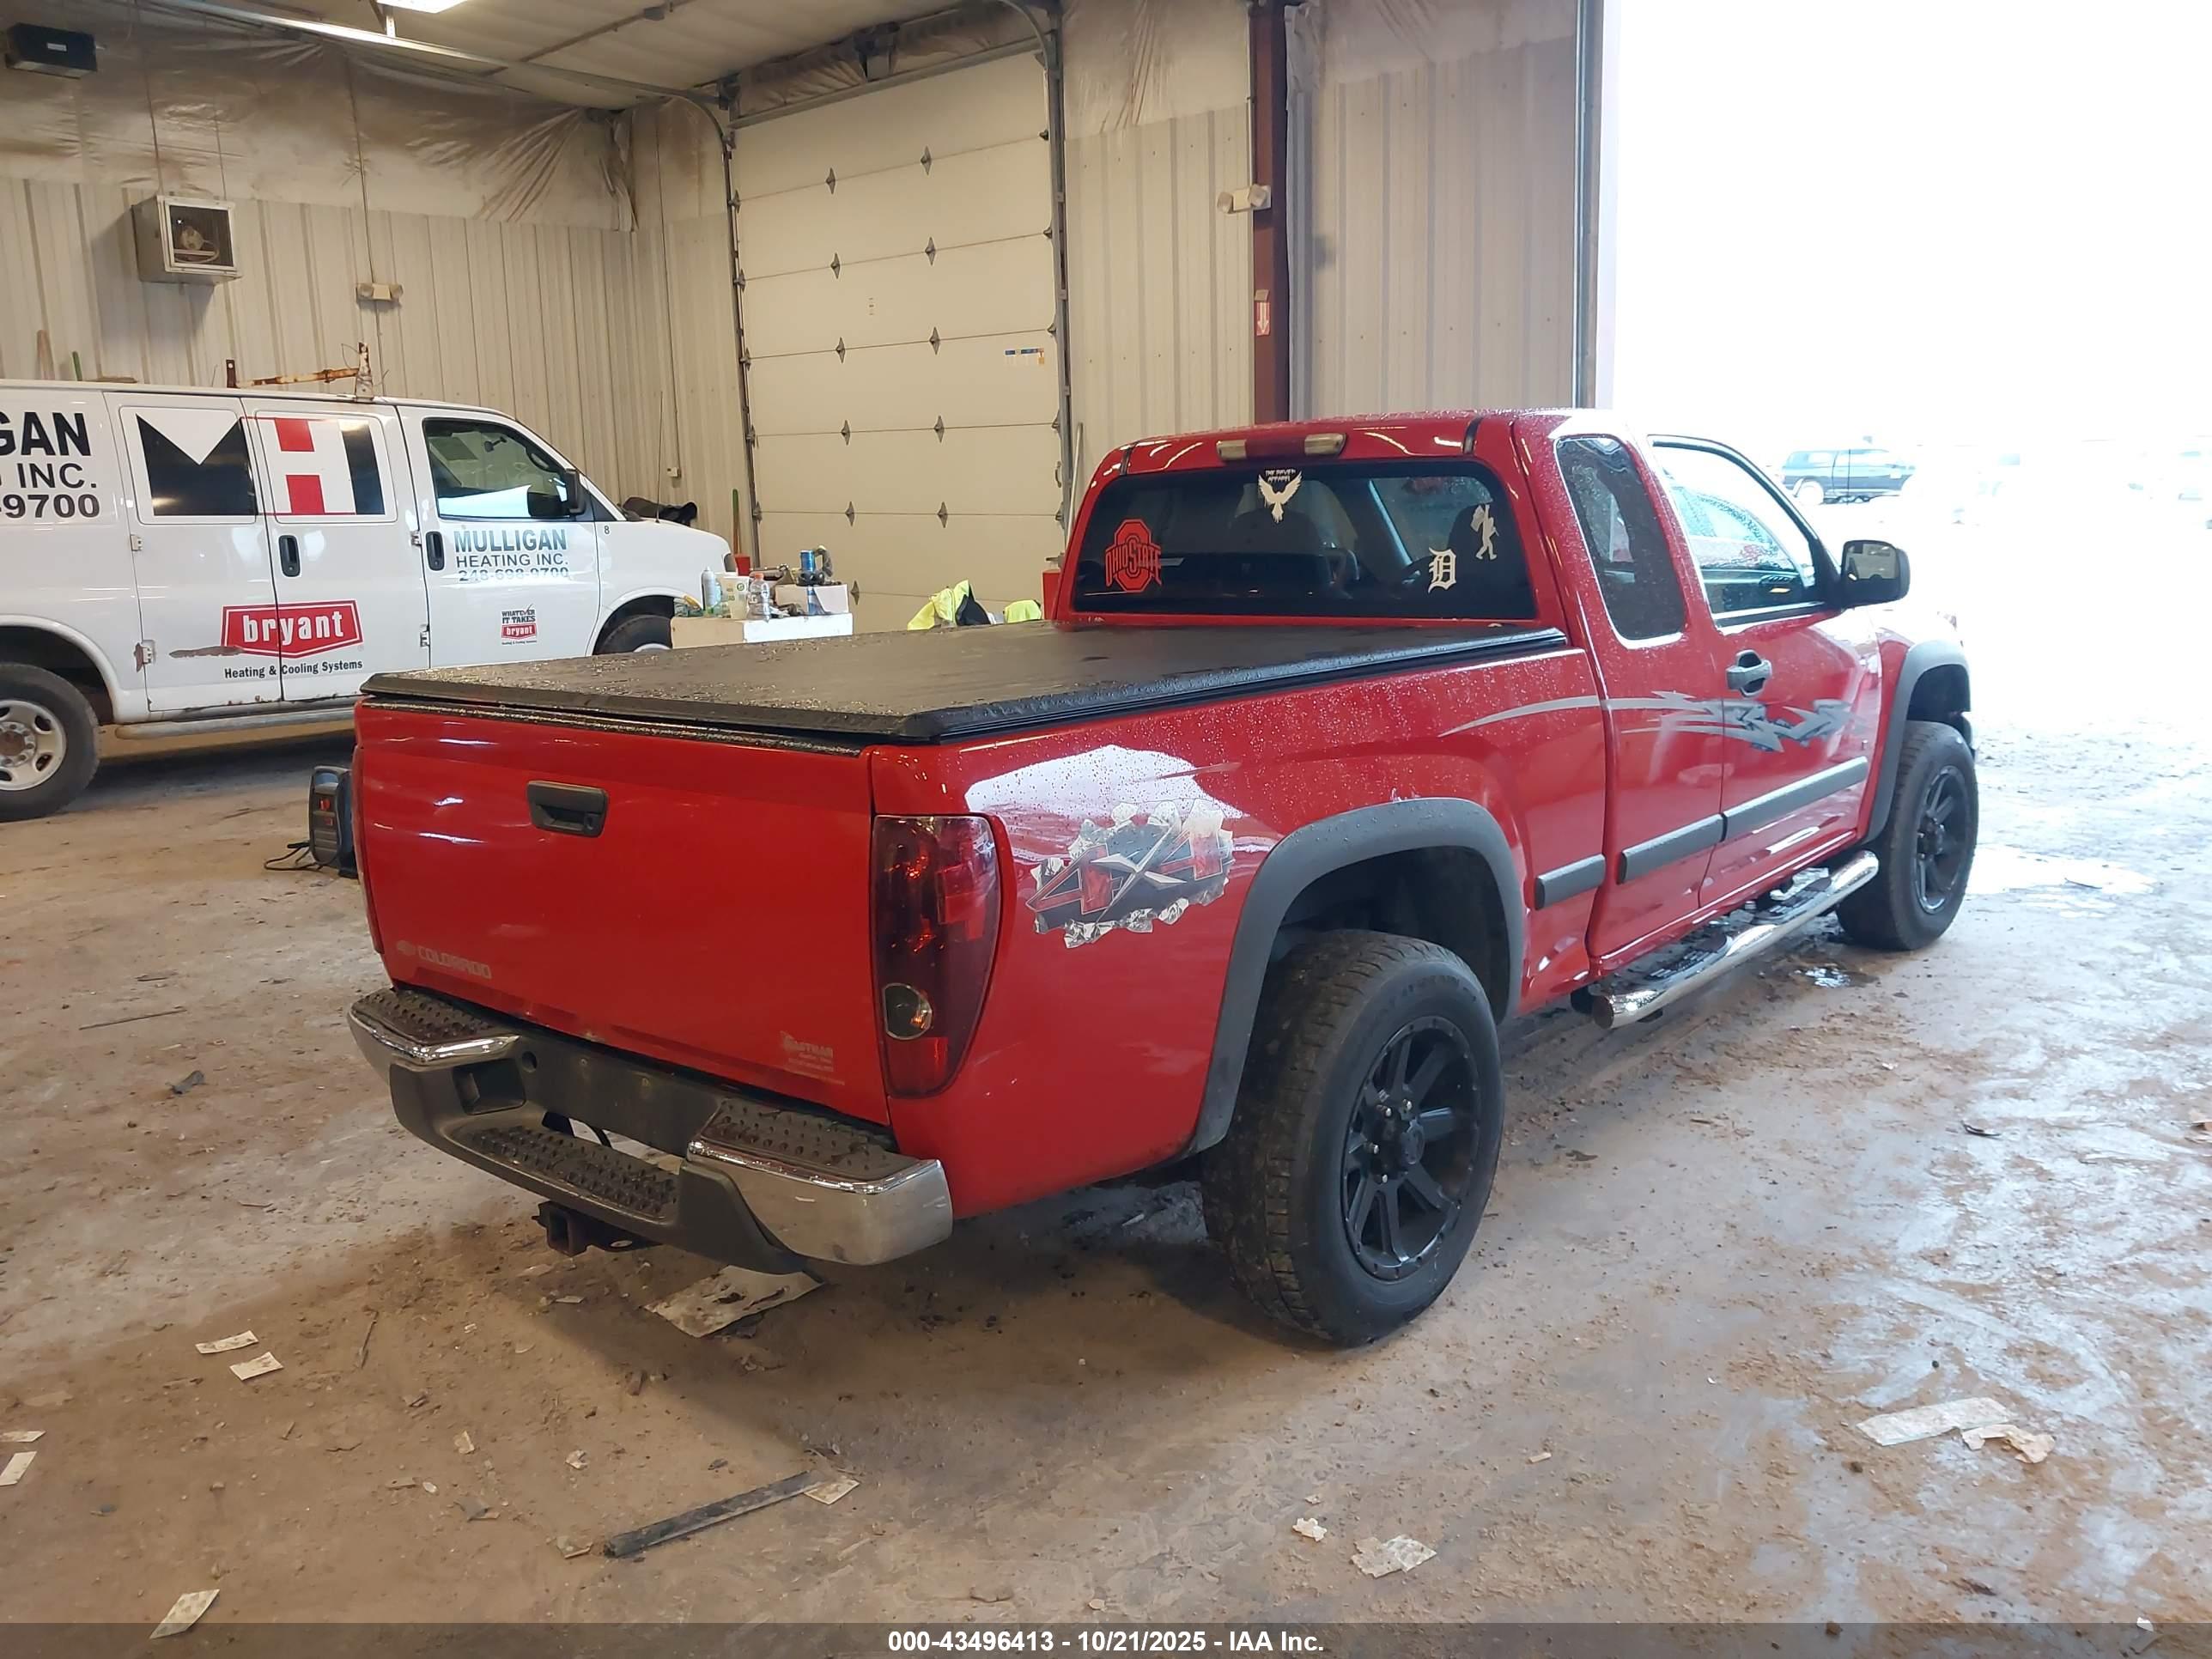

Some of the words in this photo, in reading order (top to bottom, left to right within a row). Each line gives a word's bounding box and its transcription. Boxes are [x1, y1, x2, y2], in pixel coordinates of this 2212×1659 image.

[17, 462, 97, 489] INC.
[604, 525, 611, 535] 8
[453, 528, 568, 553] MULLIGAN
[456, 553, 531, 568] HEATING
[536, 552, 568, 566] INC.
[511, 615, 537, 623] TAKES
[241, 611, 344, 647] bryant
[506, 625, 533, 637] bryant
[224, 665, 265, 679] Heating
[269, 665, 277, 676] &
[281, 663, 319, 675] Cooling
[322, 659, 363, 673] Systems
